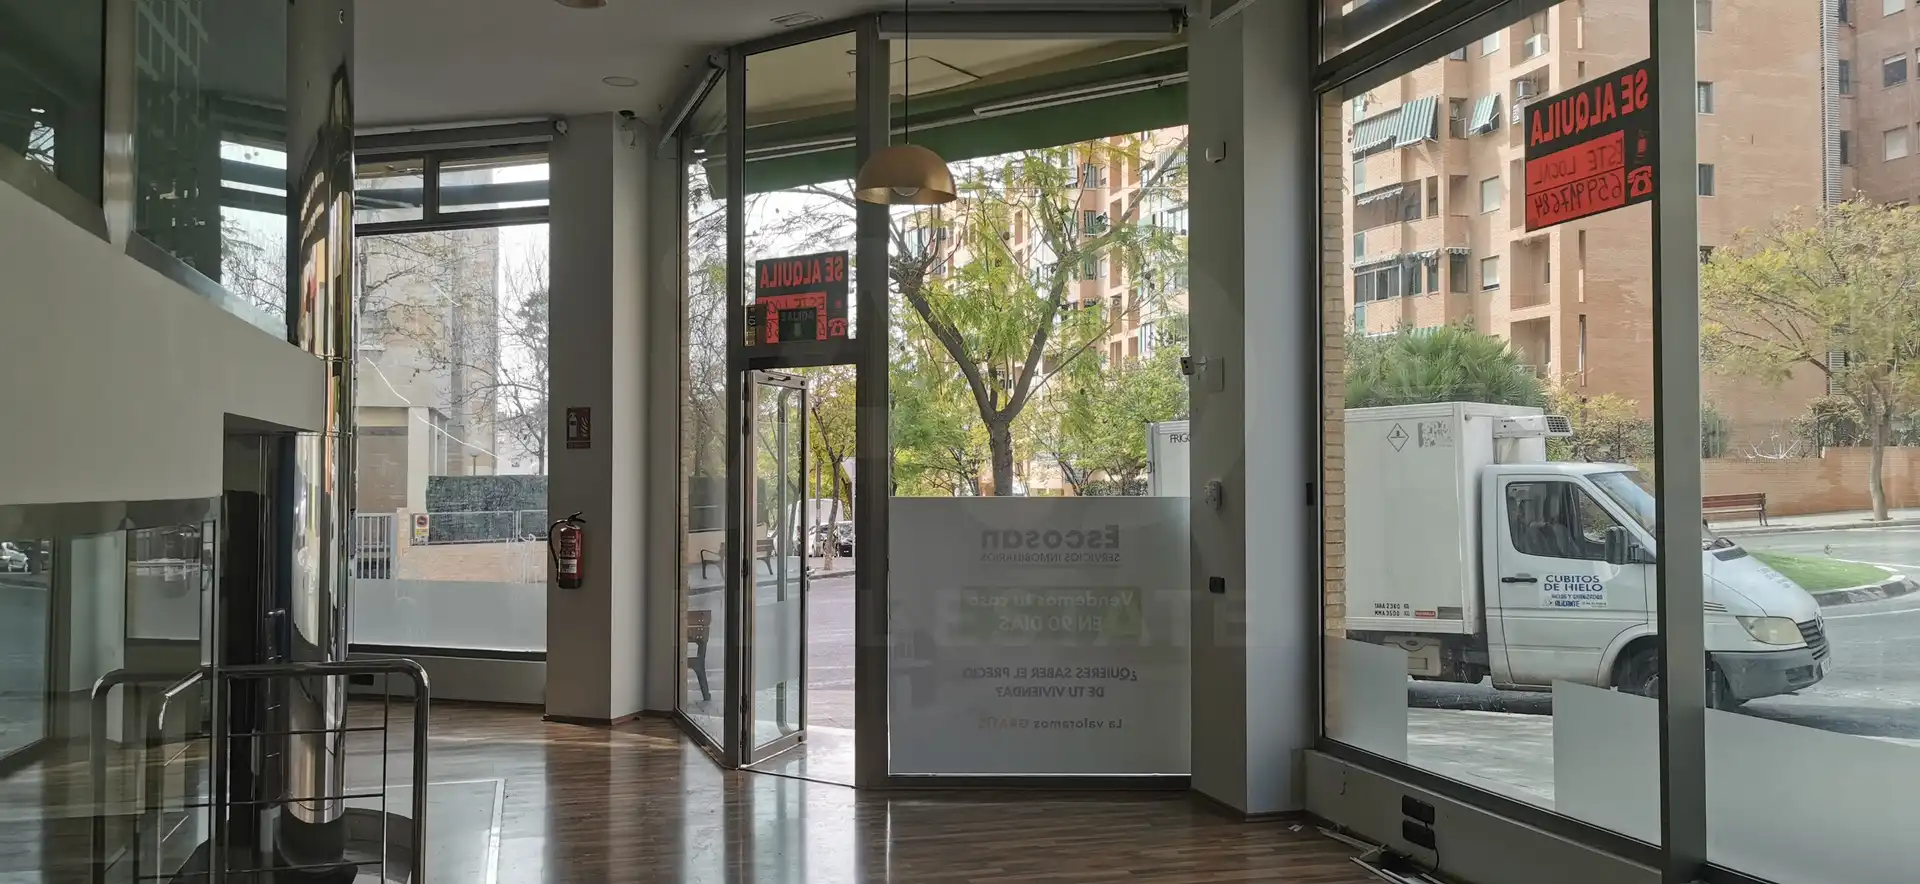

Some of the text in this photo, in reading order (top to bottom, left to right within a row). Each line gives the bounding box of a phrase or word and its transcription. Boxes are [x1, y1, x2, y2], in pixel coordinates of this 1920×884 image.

[1545, 574, 1600, 583] CUBITOS
[1544, 583, 1603, 592] DE HIELO
